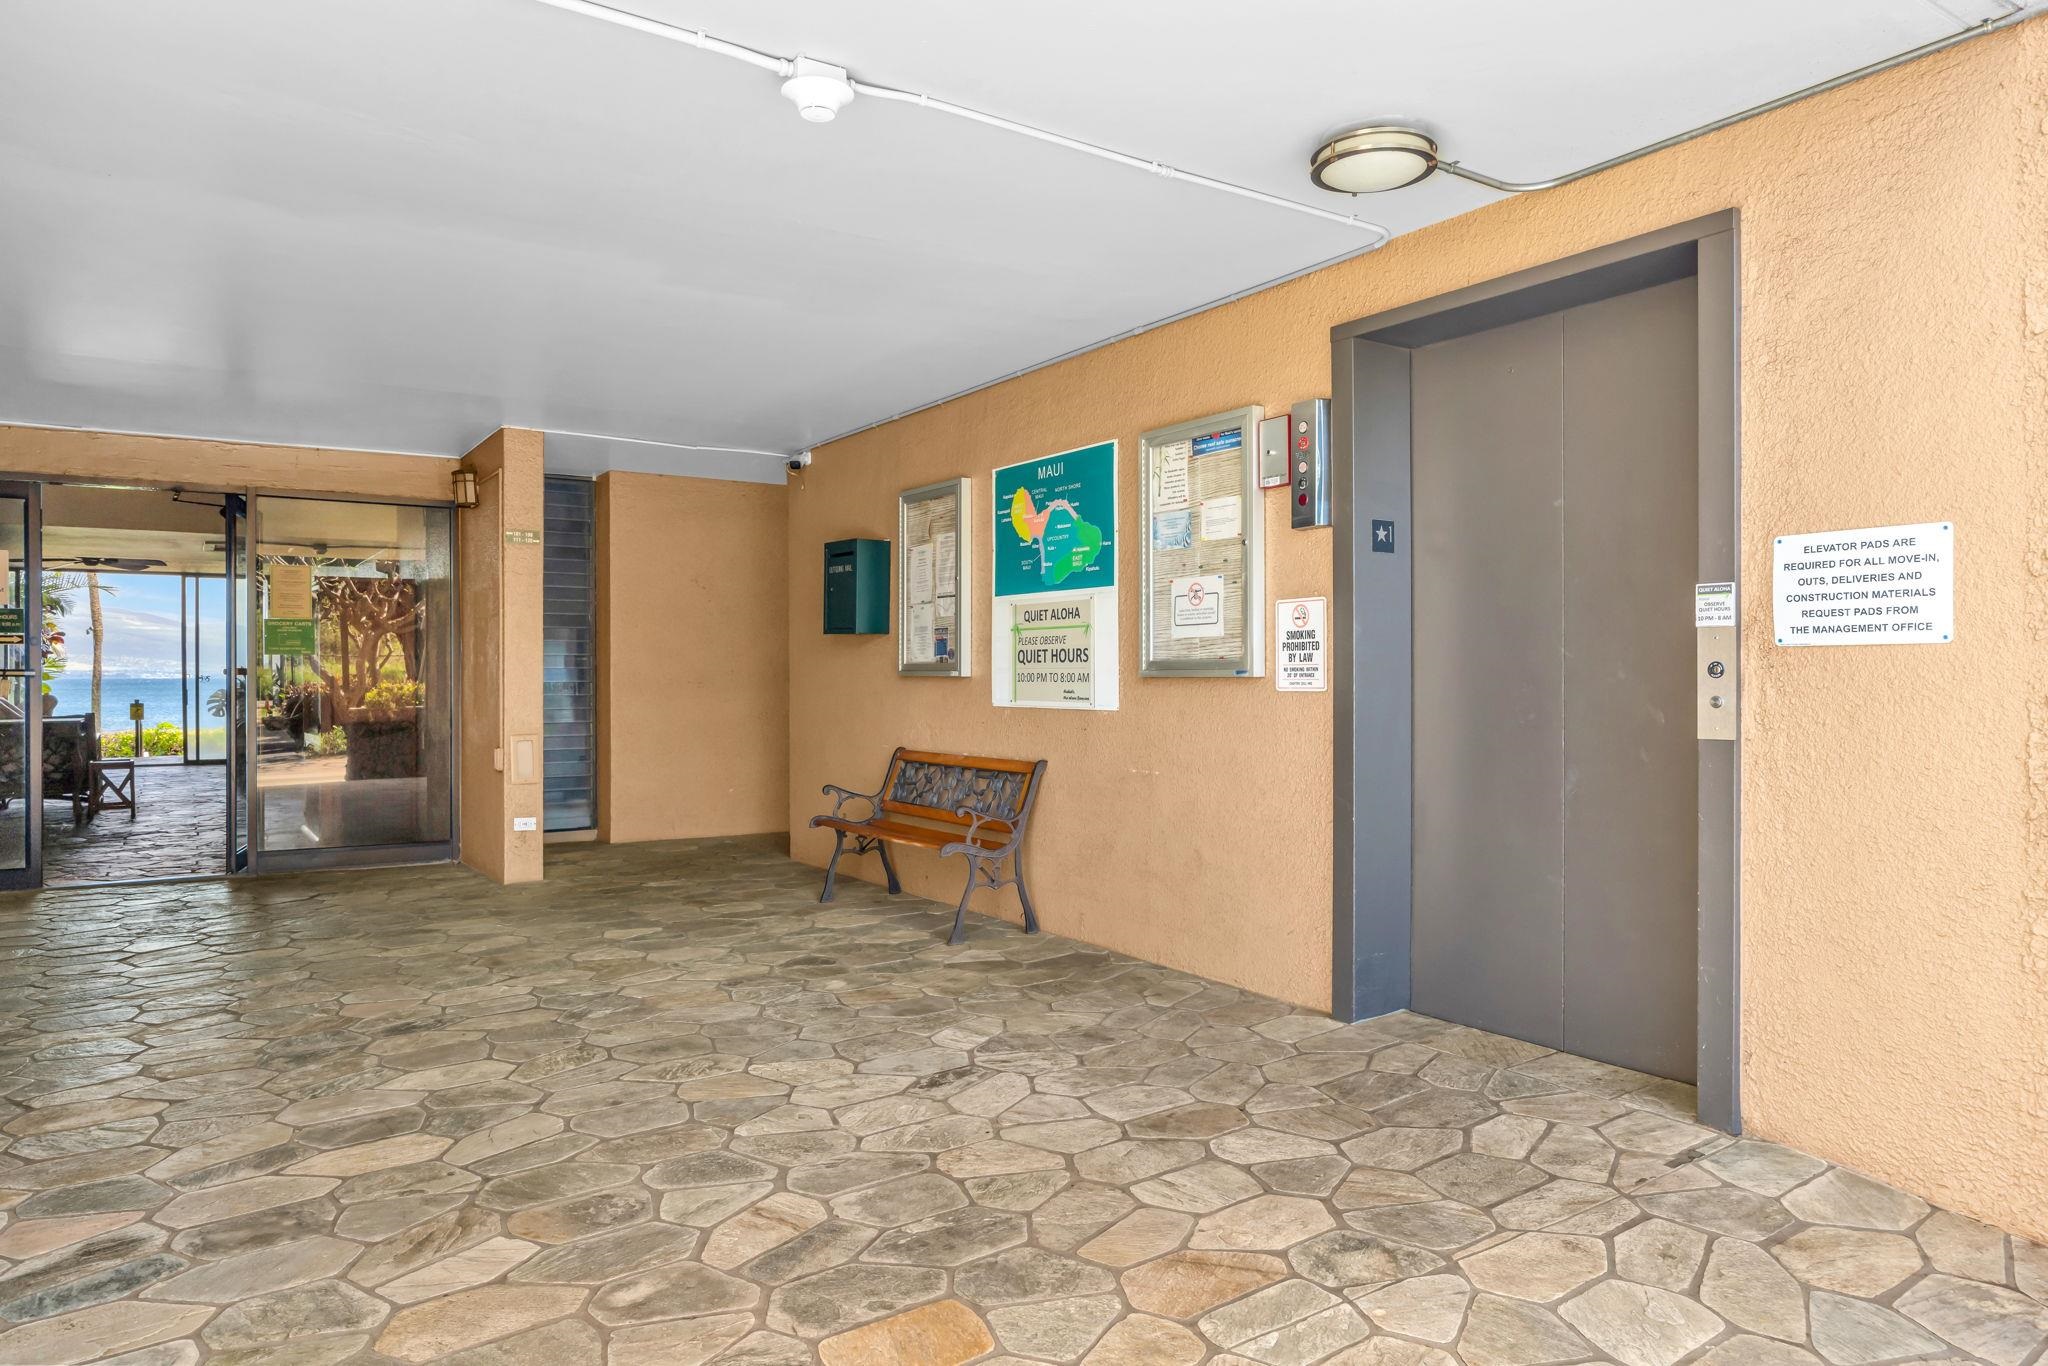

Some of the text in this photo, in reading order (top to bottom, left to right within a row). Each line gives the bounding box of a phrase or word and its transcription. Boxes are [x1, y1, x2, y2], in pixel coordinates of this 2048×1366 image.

[1038, 462, 1064, 480] MAUI
[1804, 538, 1916, 554] ELEVATOR PADS ARE
[1784, 553, 1940, 571] REQUIRED FOR ALL MOVE-IN,
[1798, 571, 1922, 586] OUTS, DELIVERIES AND
[1786, 588, 1936, 603] CONSTRUCTION MATERIALS
[1024, 607, 1080, 623] QUIET ALOHA
[1801, 606, 1919, 618] REQUEST PADS FROM
[1790, 622, 1933, 634] THE MANAGEMENT OFFICE
[1018, 635, 1067, 646] PLEASE OBSERVE
[1286, 630, 1316, 640] SMOKING
[1282, 641, 1320, 652] PROHIBITED
[1018, 648, 1089, 665] QUIET HOURS
[1288, 652, 1313, 662] BY LAW
[1017, 673, 1090, 683] 10:00 PM TO 8:00 AM
